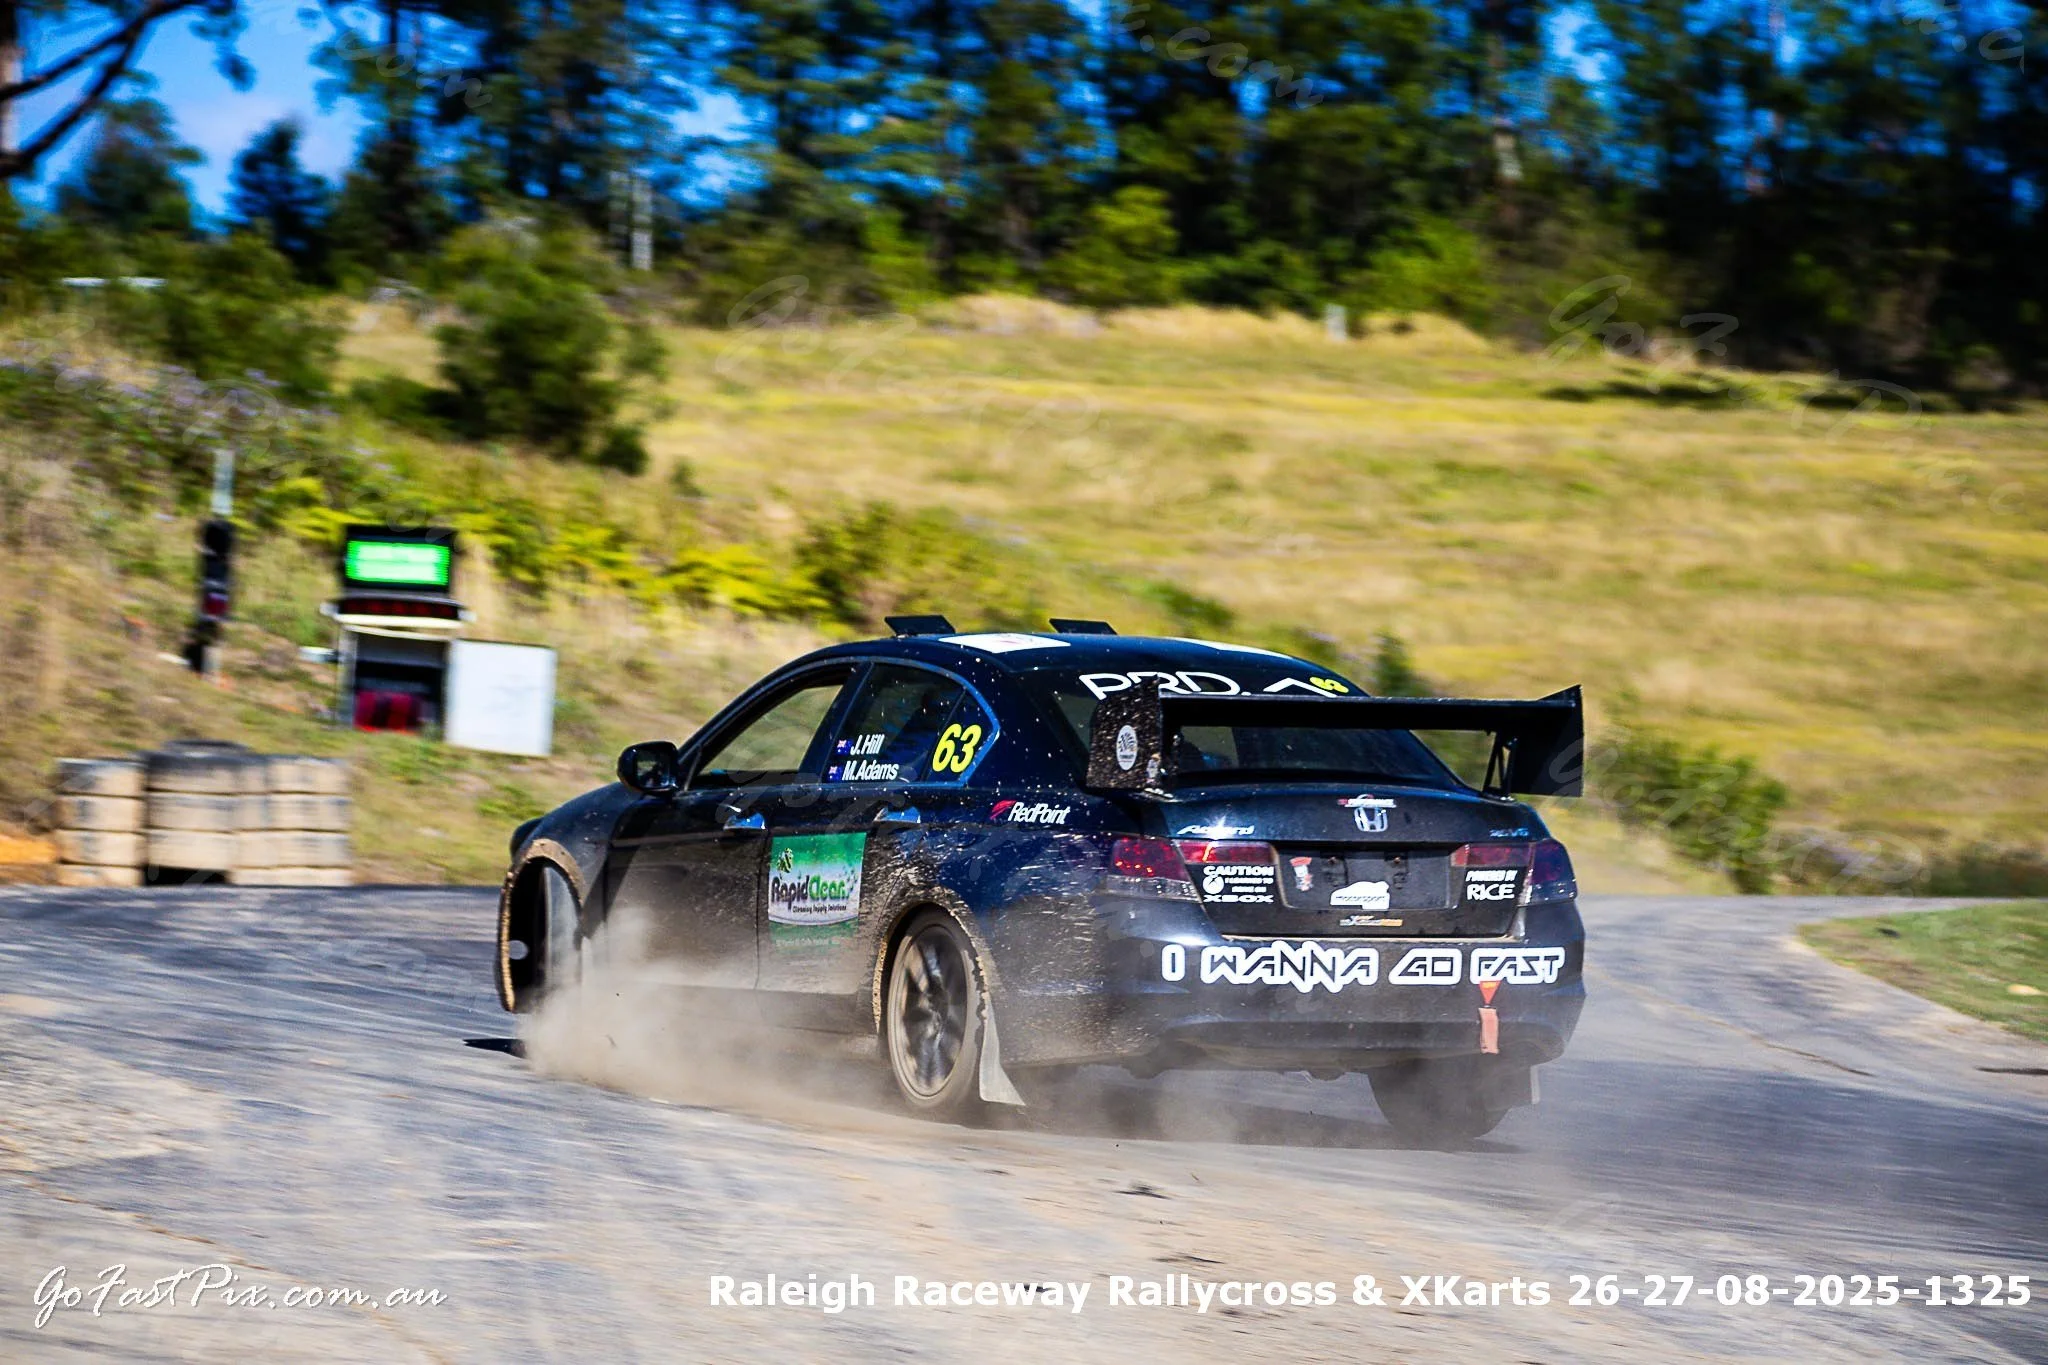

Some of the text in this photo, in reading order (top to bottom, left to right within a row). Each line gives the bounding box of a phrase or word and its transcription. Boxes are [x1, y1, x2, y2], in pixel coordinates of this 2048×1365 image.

[932, 723, 982, 773] 63
[841, 759, 899, 781] M.Adams
[1007, 801, 1070, 825] RedPoint
[1203, 866, 1274, 876] CAUTION
[1467, 884, 1515, 900] RICE
[1201, 941, 1379, 993] WANNA
[1389, 948, 1463, 985] GO
[1470, 947, 1566, 985] FAST
